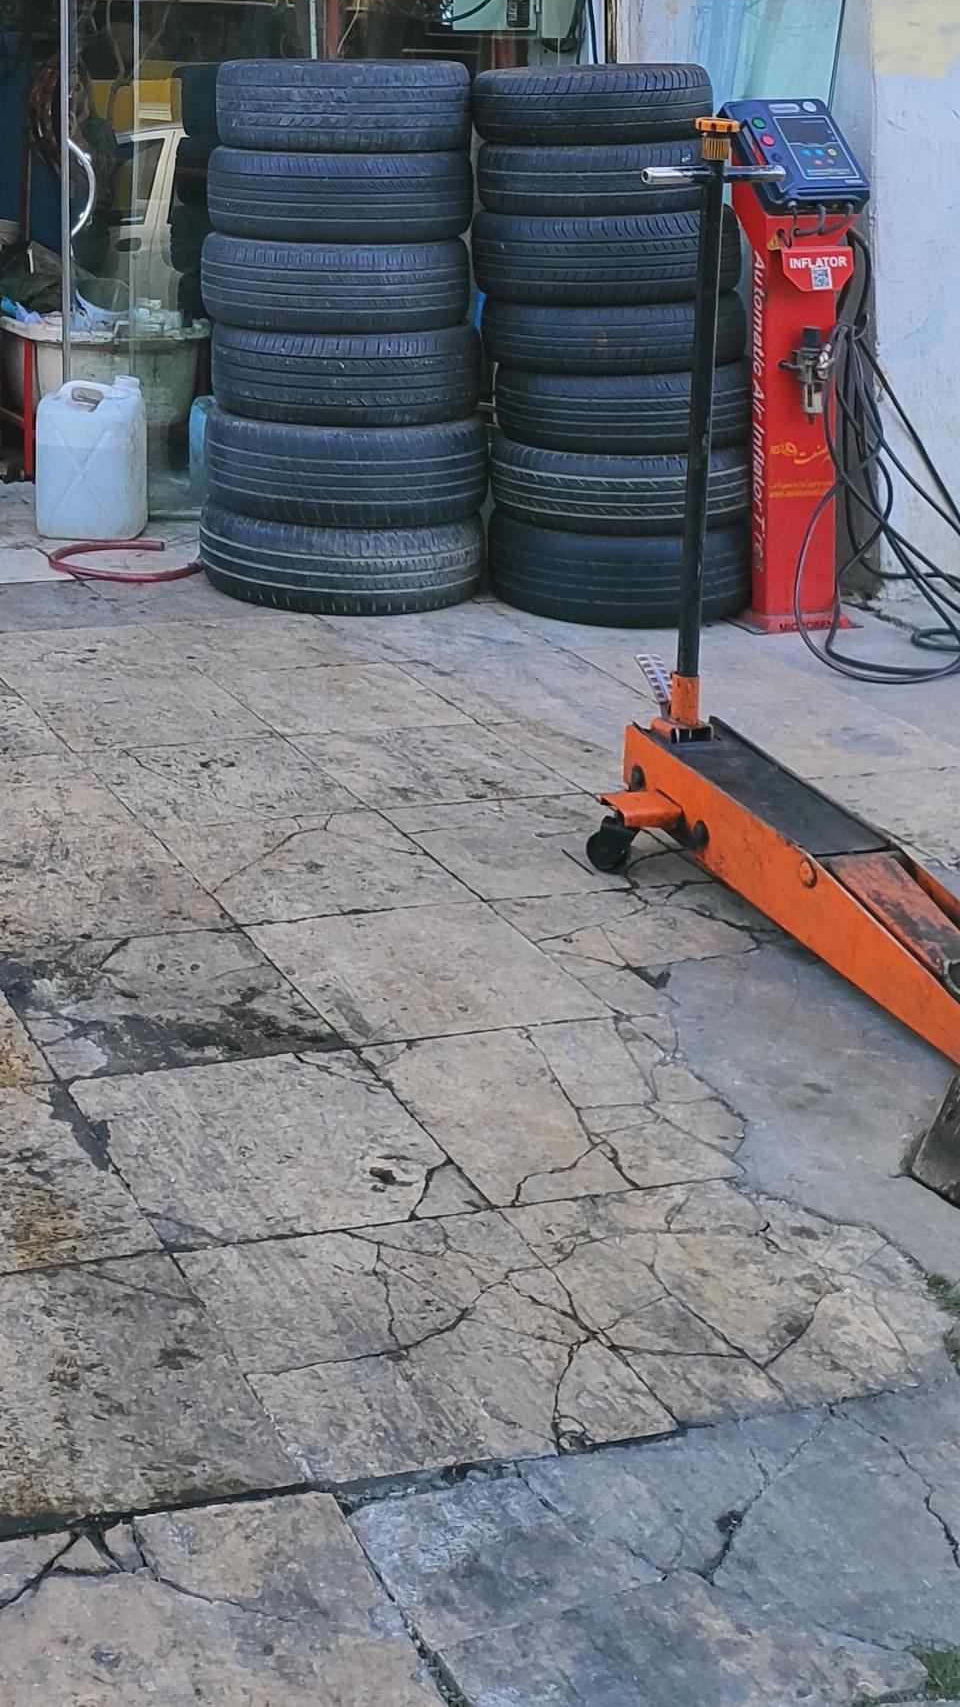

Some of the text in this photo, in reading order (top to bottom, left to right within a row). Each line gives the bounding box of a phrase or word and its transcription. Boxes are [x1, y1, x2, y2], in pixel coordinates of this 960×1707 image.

[789, 256, 848, 269] INFLATOR
[753, 250, 766, 378] Automatic
[753, 379, 766, 420] Air
[753, 421, 766, 513] Inflator
[779, 619, 842, 631] MICOSEN
